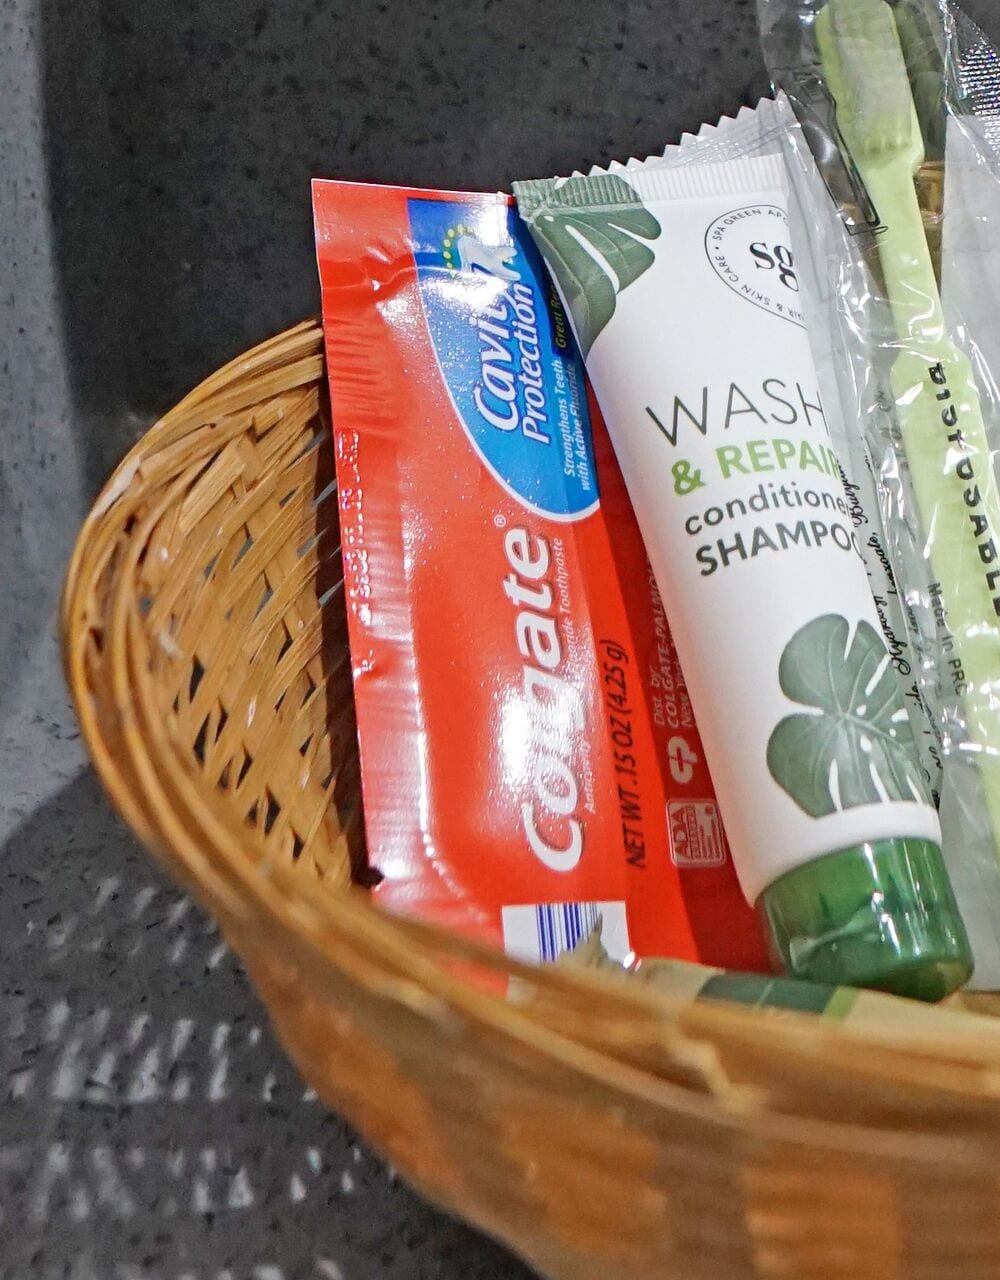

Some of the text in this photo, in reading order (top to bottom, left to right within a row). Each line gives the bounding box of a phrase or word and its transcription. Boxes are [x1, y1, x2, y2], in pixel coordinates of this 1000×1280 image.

[723, 208, 762, 225] GREEN
[715, 255, 739, 282] CARE
[741, 284, 771, 306] SKIN
[511, 282, 551, 445] Protection
[551, 359, 576, 477] Strengthens Teeth
[645, 378, 830, 448] WASH
[572, 420, 587, 460] Active
[575, 460, 591, 491] with
[671, 458, 706, 496] &
[553, 537, 575, 615] Toothpaste
[610, 714, 632, 749] OZ
[619, 786, 641, 821] WT
[621, 823, 647, 870] NET
